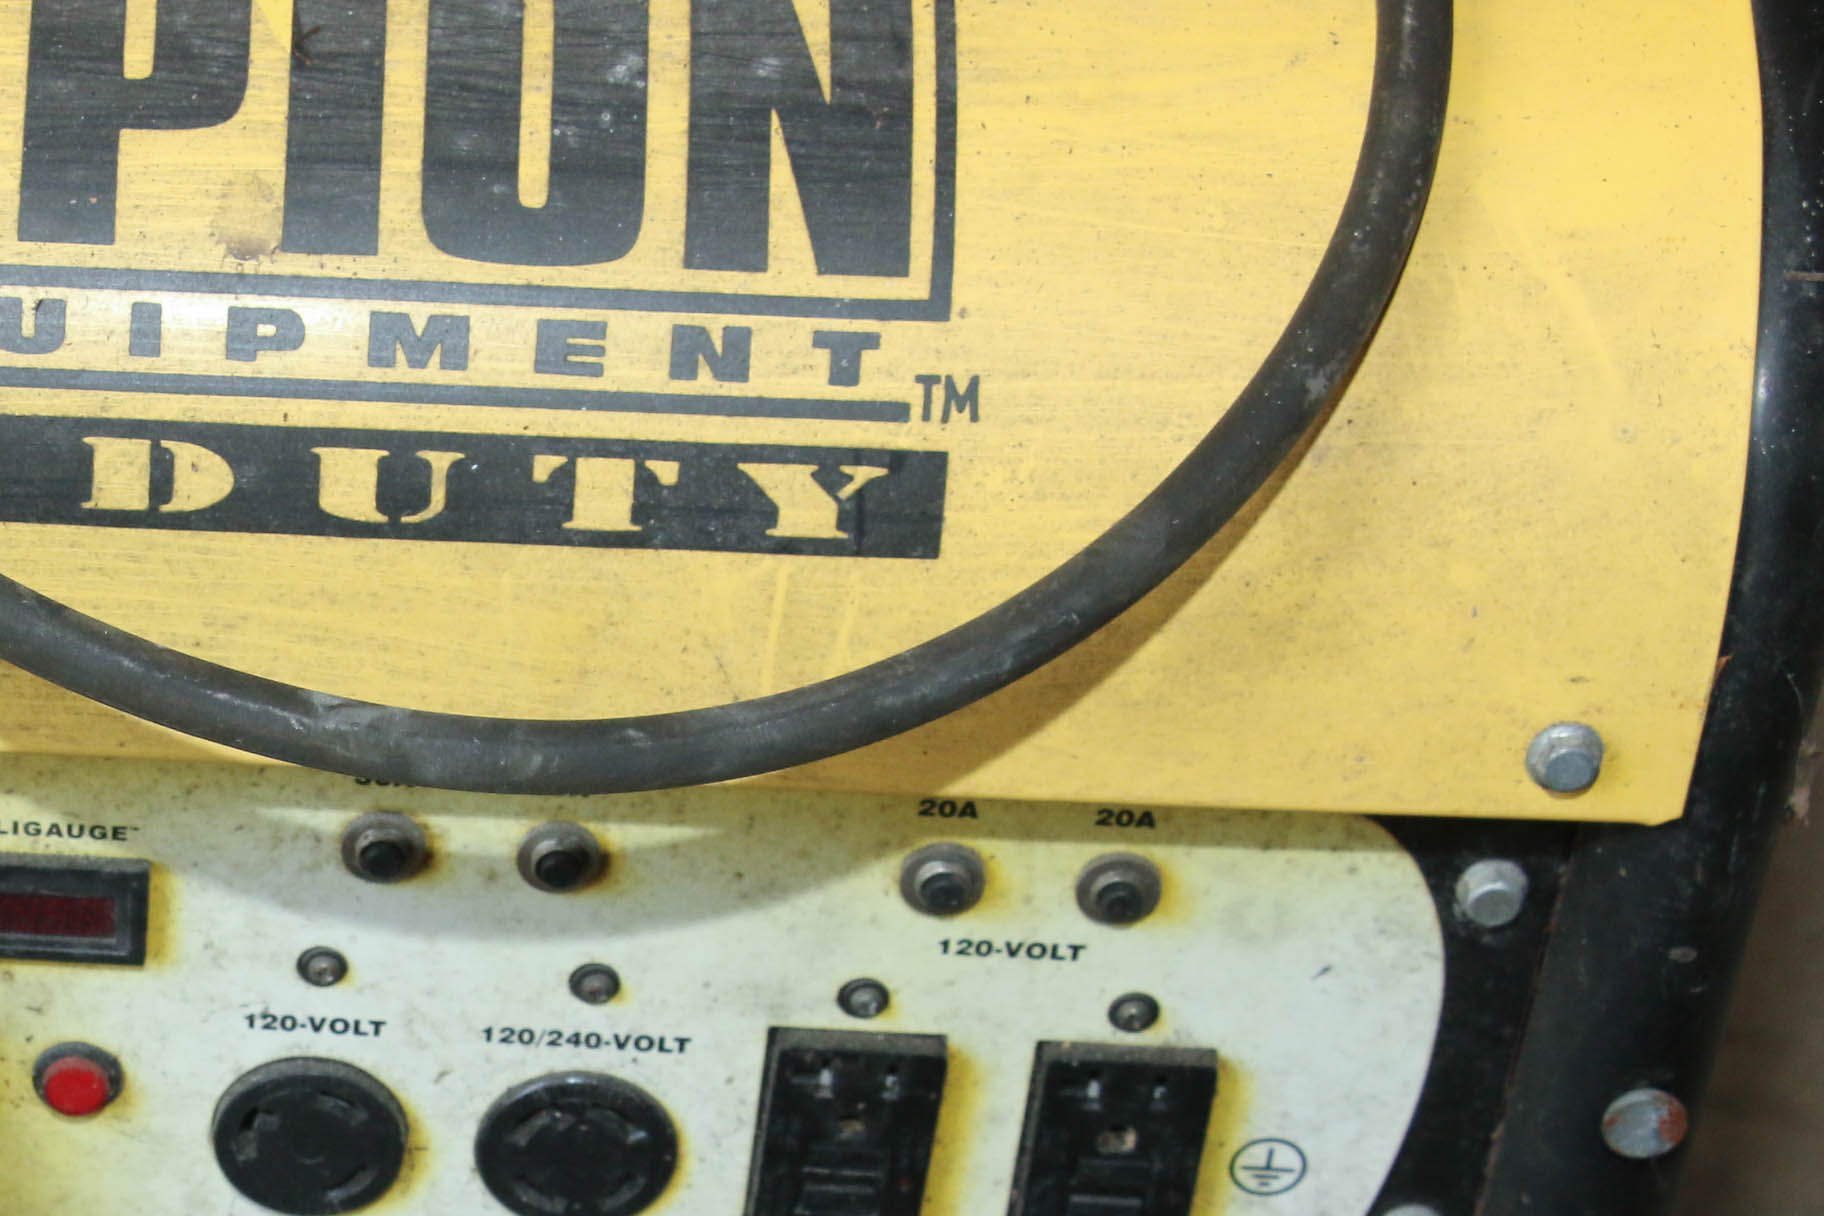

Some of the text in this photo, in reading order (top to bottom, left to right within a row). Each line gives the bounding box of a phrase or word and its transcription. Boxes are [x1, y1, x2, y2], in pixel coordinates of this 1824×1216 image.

[916, 373, 980, 424] TM
[80, 436, 888, 541] DUTY
[918, 800, 978, 818] 20A
[1096, 808, 1156, 829] 20A
[938, 938, 1087, 961] 120-VOLT
[245, 1014, 386, 1036] 120-VOLT
[482, 1027, 692, 1053] 120/240-VOLT
